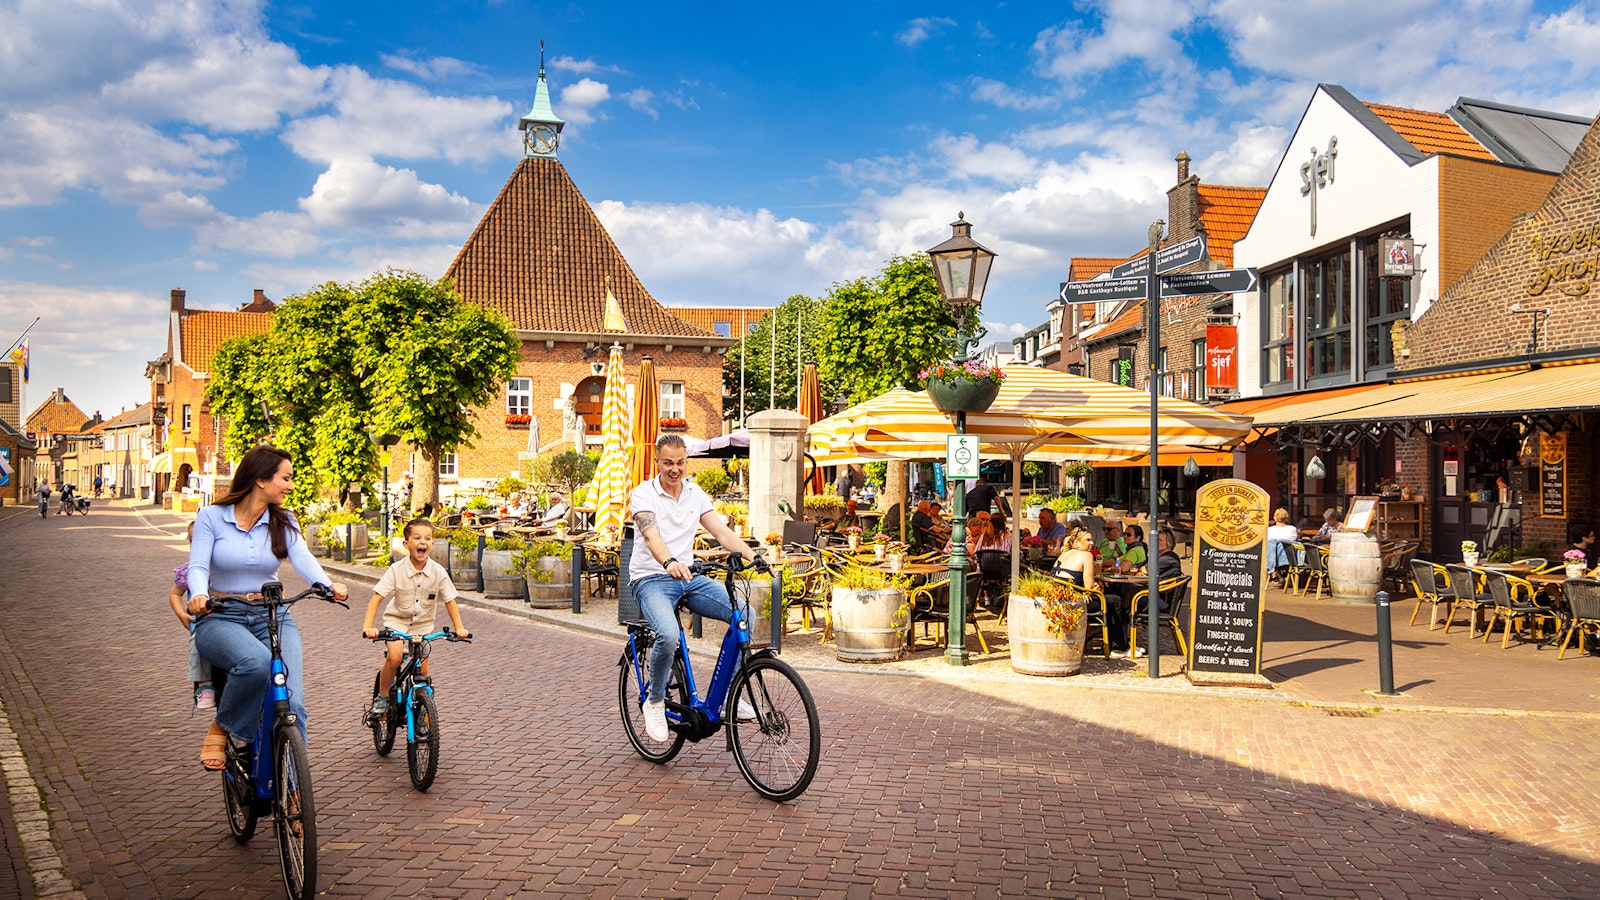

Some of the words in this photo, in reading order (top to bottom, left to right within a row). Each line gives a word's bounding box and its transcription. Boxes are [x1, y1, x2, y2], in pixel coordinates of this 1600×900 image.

[1300, 135, 1338, 239] sjef
[1207, 272, 1231, 280] Lemmen
[1104, 279, 1138, 287] Arcen-Lottum
[1119, 359, 1132, 386] Grolsc
[1211, 354, 1231, 379] sjef
[1212, 487, 1225, 499] ETEN
[1234, 487, 1255, 502] DRINKEN
[1221, 536, 1243, 544] ARCEN
[1205, 570, 1252, 587] Grillspecials
[1201, 588, 1229, 599] Burgers
[1232, 590, 1237, 598] &
[1240, 591, 1254, 599] ribs
[1207, 600, 1222, 610] FISH
[1222, 601, 1228, 610] &
[1199, 615, 1222, 625] SALADS
[1225, 617, 1230, 625] &
[1232, 617, 1253, 627] SOUPS
[1195, 642, 1226, 652] Breakfast
[1233, 645, 1254, 654] Lunch
[1198, 655, 1219, 665] BEERS
[1220, 657, 1225, 665] &
[1228, 657, 1249, 667] WINES
